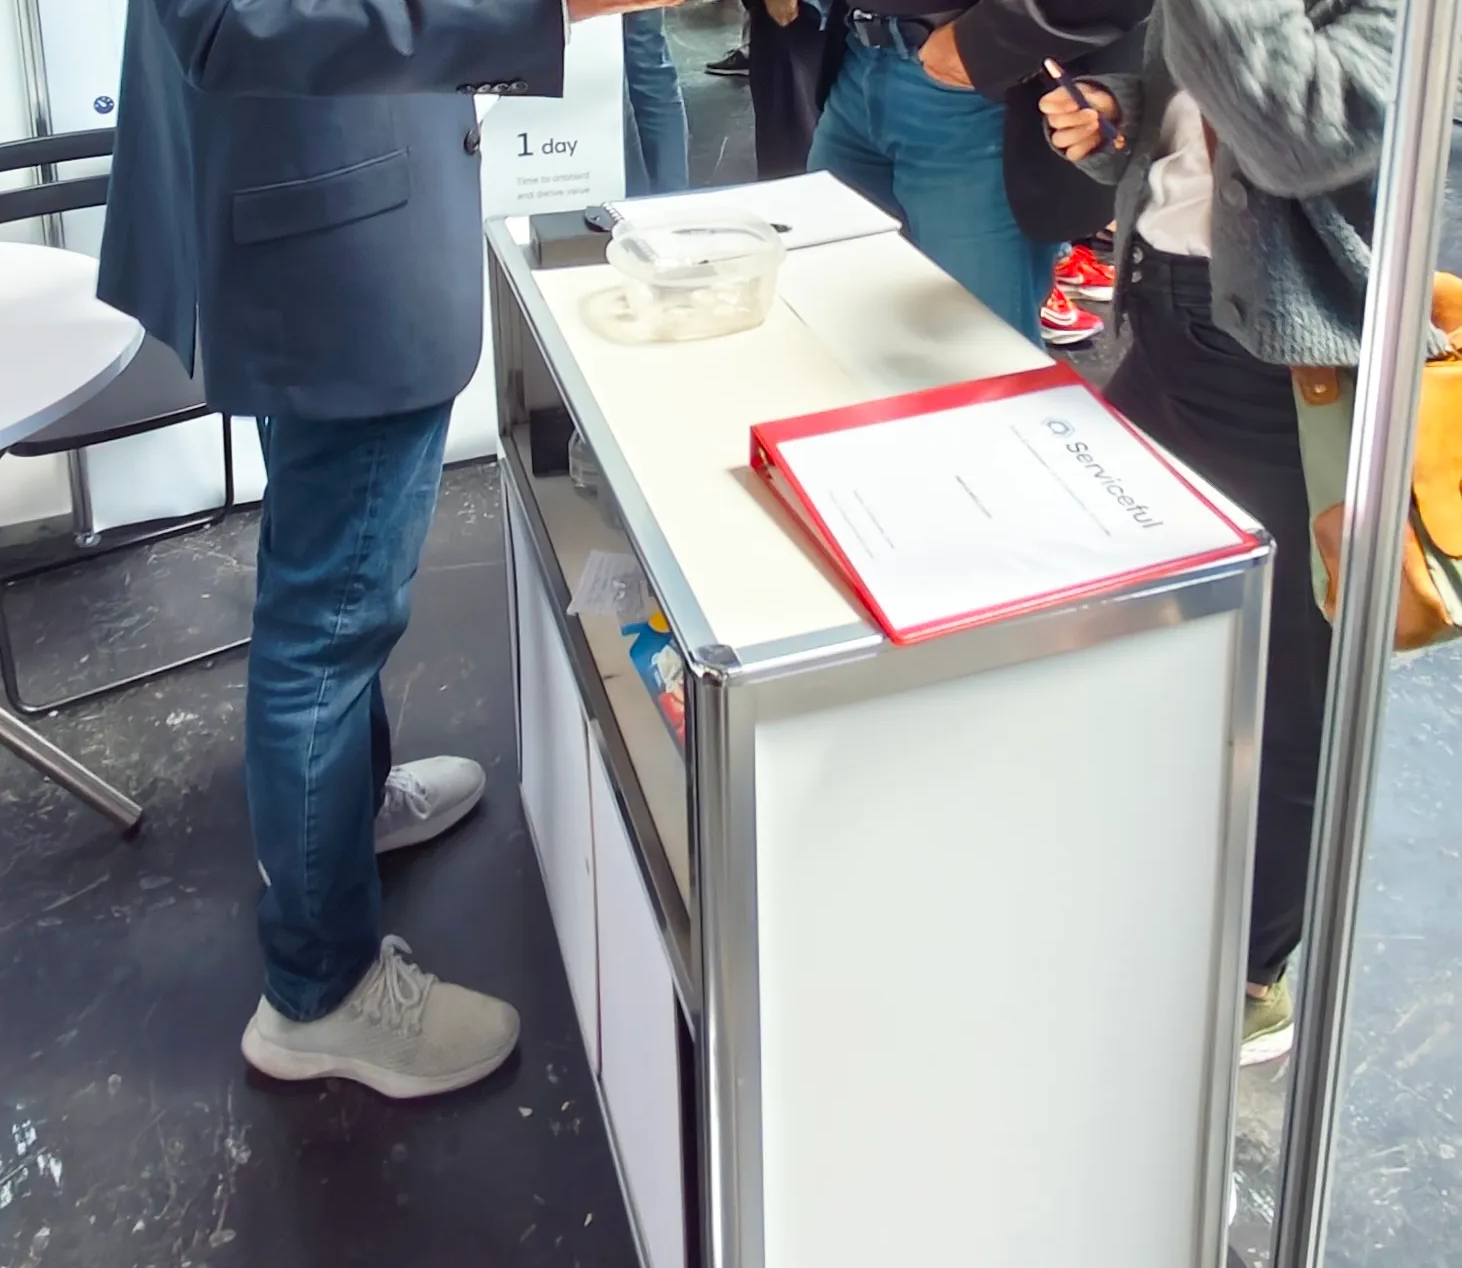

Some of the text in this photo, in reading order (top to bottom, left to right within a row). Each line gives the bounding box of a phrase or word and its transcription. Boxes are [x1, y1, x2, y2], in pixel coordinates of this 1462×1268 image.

[517, 132, 578, 157] 1 day
[1065, 441, 1164, 529] Serviceful
